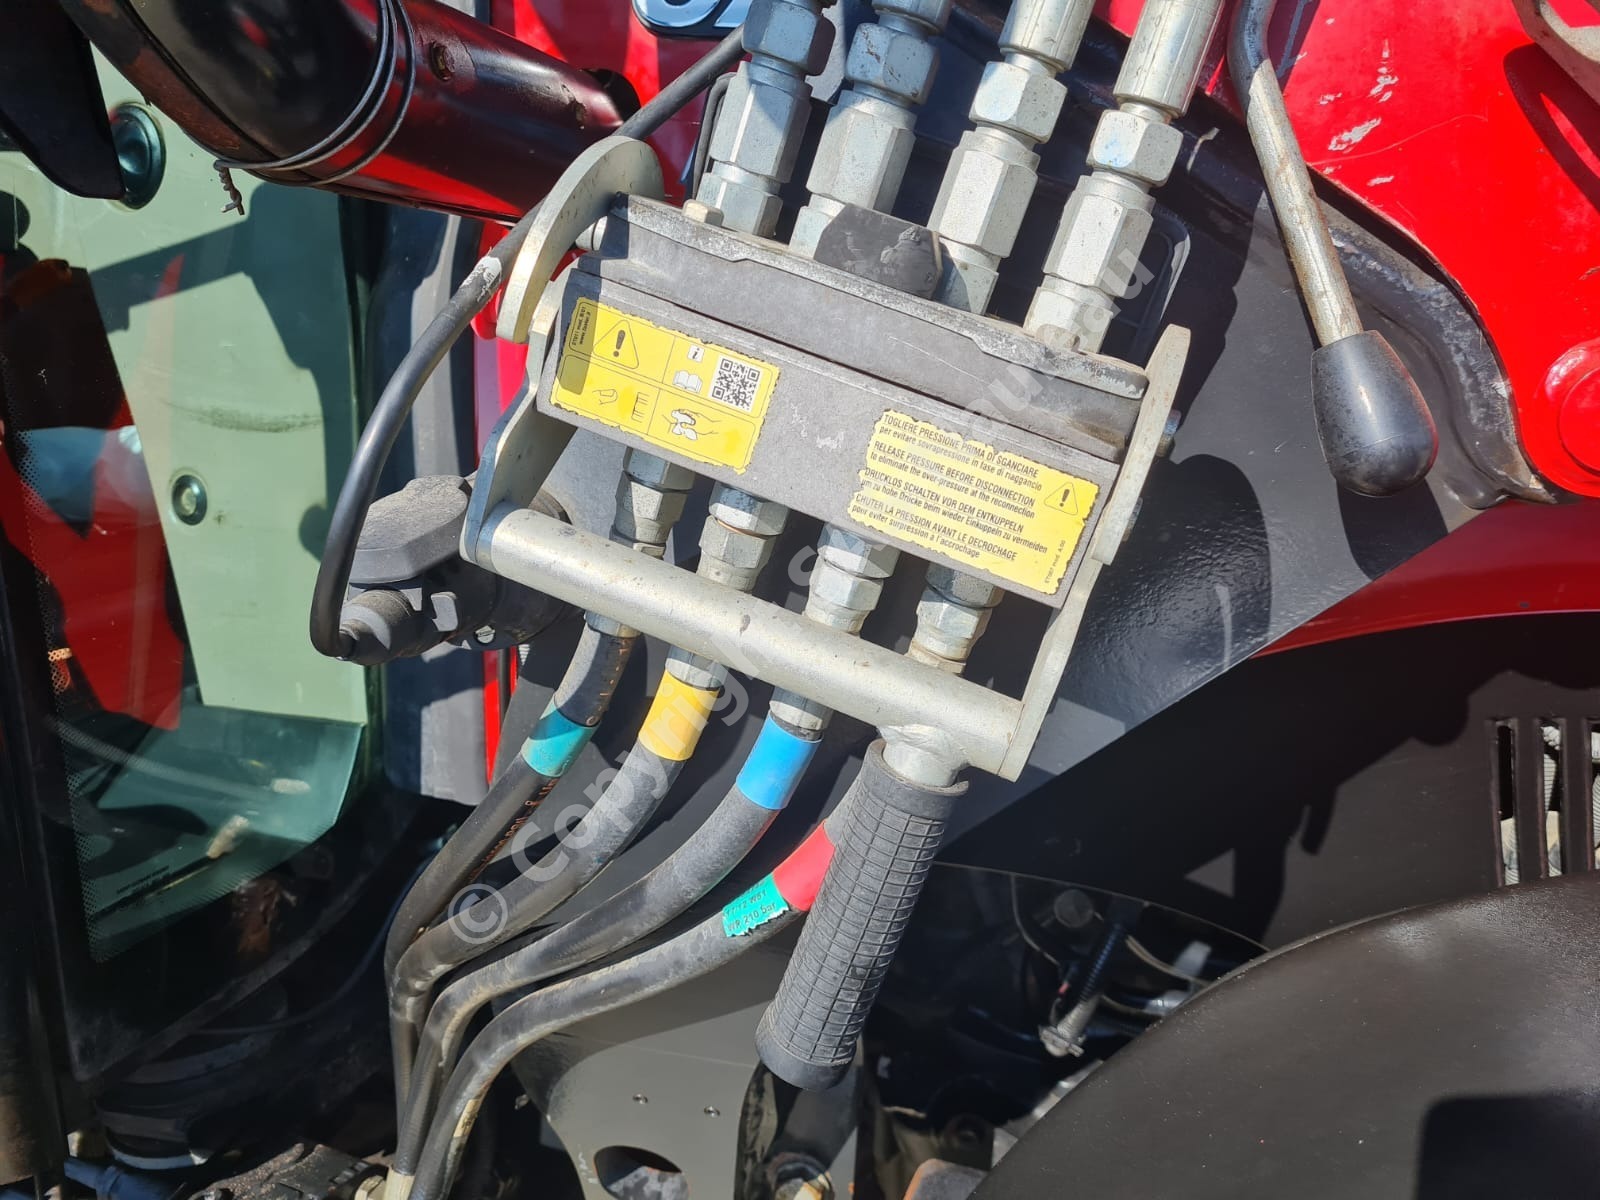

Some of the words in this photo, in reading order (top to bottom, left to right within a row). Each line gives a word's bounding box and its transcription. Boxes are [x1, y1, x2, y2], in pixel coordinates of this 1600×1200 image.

[873, 441, 906, 459] RELEASE
[905, 453, 946, 474] PRESSURE
[945, 467, 976, 484] BEFORE
[974, 479, 1036, 507] DISCONNECTION
[878, 426, 892, 437] per
[892, 430, 918, 445] evitare
[917, 440, 971, 465] sovrapressione
[971, 459, 980, 468] in
[979, 462, 996, 473] fase
[996, 467, 1005, 476] di
[883, 414, 919, 434] TOGLIERE
[918, 427, 961, 449] PRESSIONE
[960, 442, 986, 458] PRIMA
[986, 452, 997, 462] DI
[995, 456, 1040, 478] SGANCIARE
[861, 480, 873, 489] um
[872, 483, 881, 491] zu
[881, 485, 899, 498] hohe
[923, 501, 942, 514] beim
[941, 508, 966, 522] wieder
[964, 518, 1002, 538] Einkuppeln
[1002, 532, 1011, 540] zu
[1011, 535, 1049, 553] vermeiden
[863, 467, 903, 488] DRUCKLOS
[903, 481, 941, 502] SCHALTEN
[941, 496, 959, 509] VOR
[958, 502, 976, 515] DEM
[975, 509, 1025, 534] ENTKUPPELN
[870, 452, 878, 461] to
[878, 455, 910, 472] eliminate
[909, 466, 921, 476] the
[921, 471, 970, 495] over-pressure
[969, 489, 979, 497] at
[978, 491, 992, 502] the
[990, 496, 1036, 519] reconnection
[855, 493, 887, 511] CHUTER
[885, 504, 896, 515] LA
[895, 508, 932, 528] PRESSION
[931, 522, 958, 538] AVANT
[957, 532, 968, 542] LE
[967, 536, 1018, 561] DECROCHAGE
[888, 519, 930, 539] surpression
[744, 910, 759, 924] 210
[760, 902, 776, 914] bar
